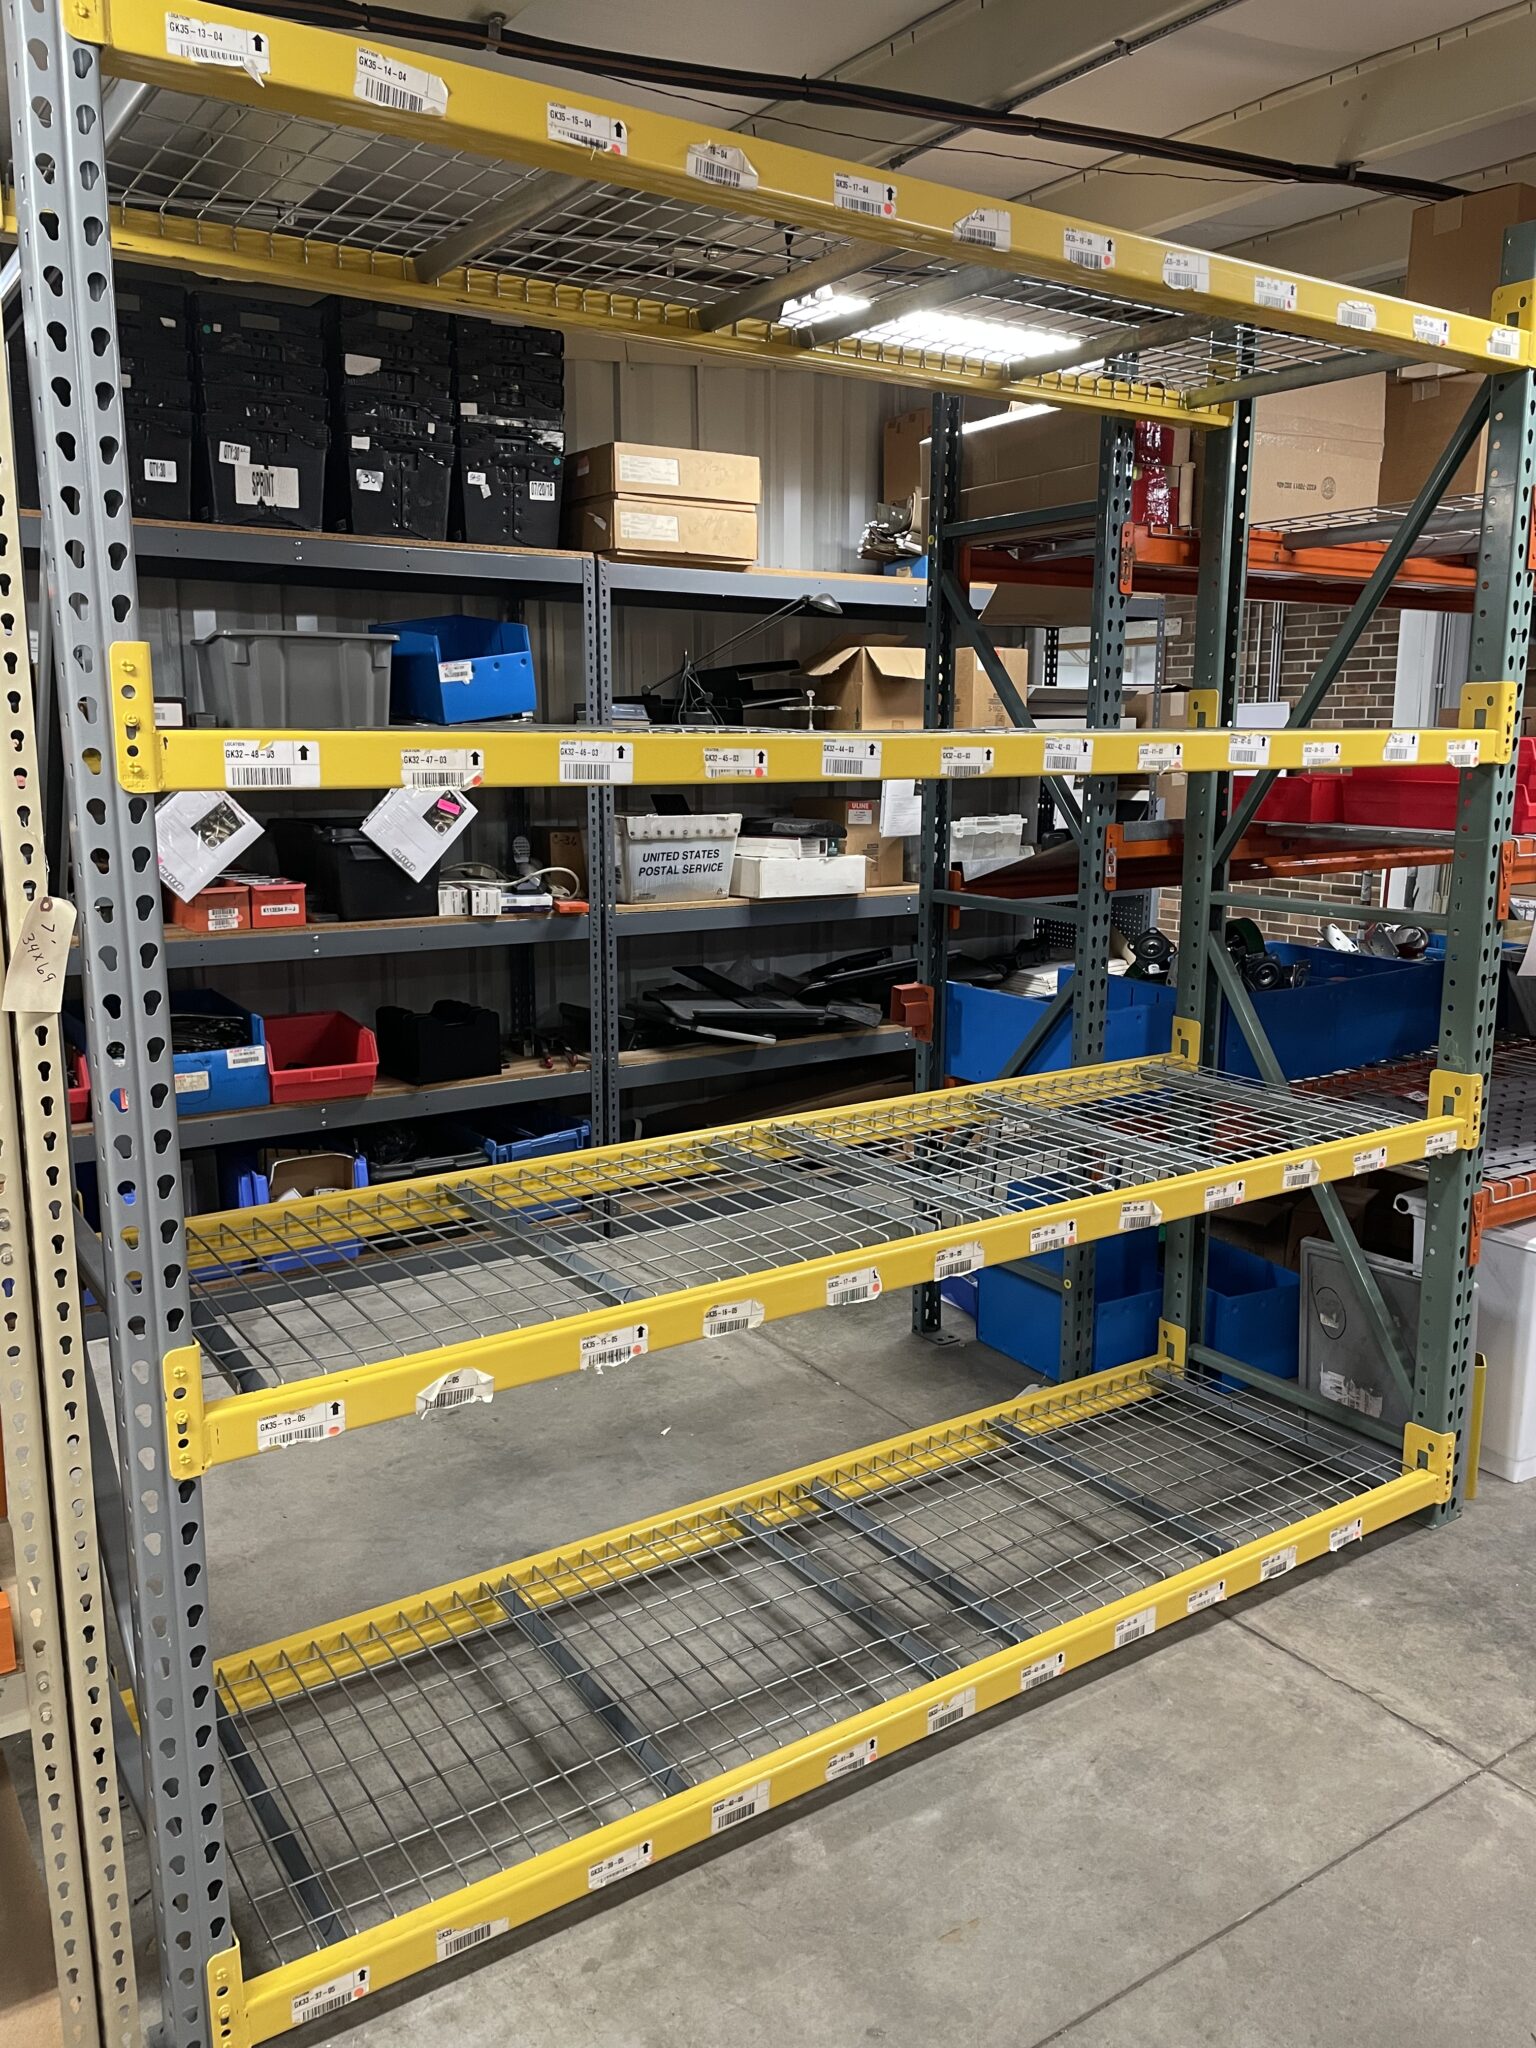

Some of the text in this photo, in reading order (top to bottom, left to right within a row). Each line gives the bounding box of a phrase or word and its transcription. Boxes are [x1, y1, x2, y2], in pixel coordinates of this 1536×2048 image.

[251, 471, 274, 497] SPRINT
[851, 802, 869, 810] ULINE
[642, 848, 720, 863] UNITED STATES
[638, 862, 724, 877] POSTAL SERVICE
